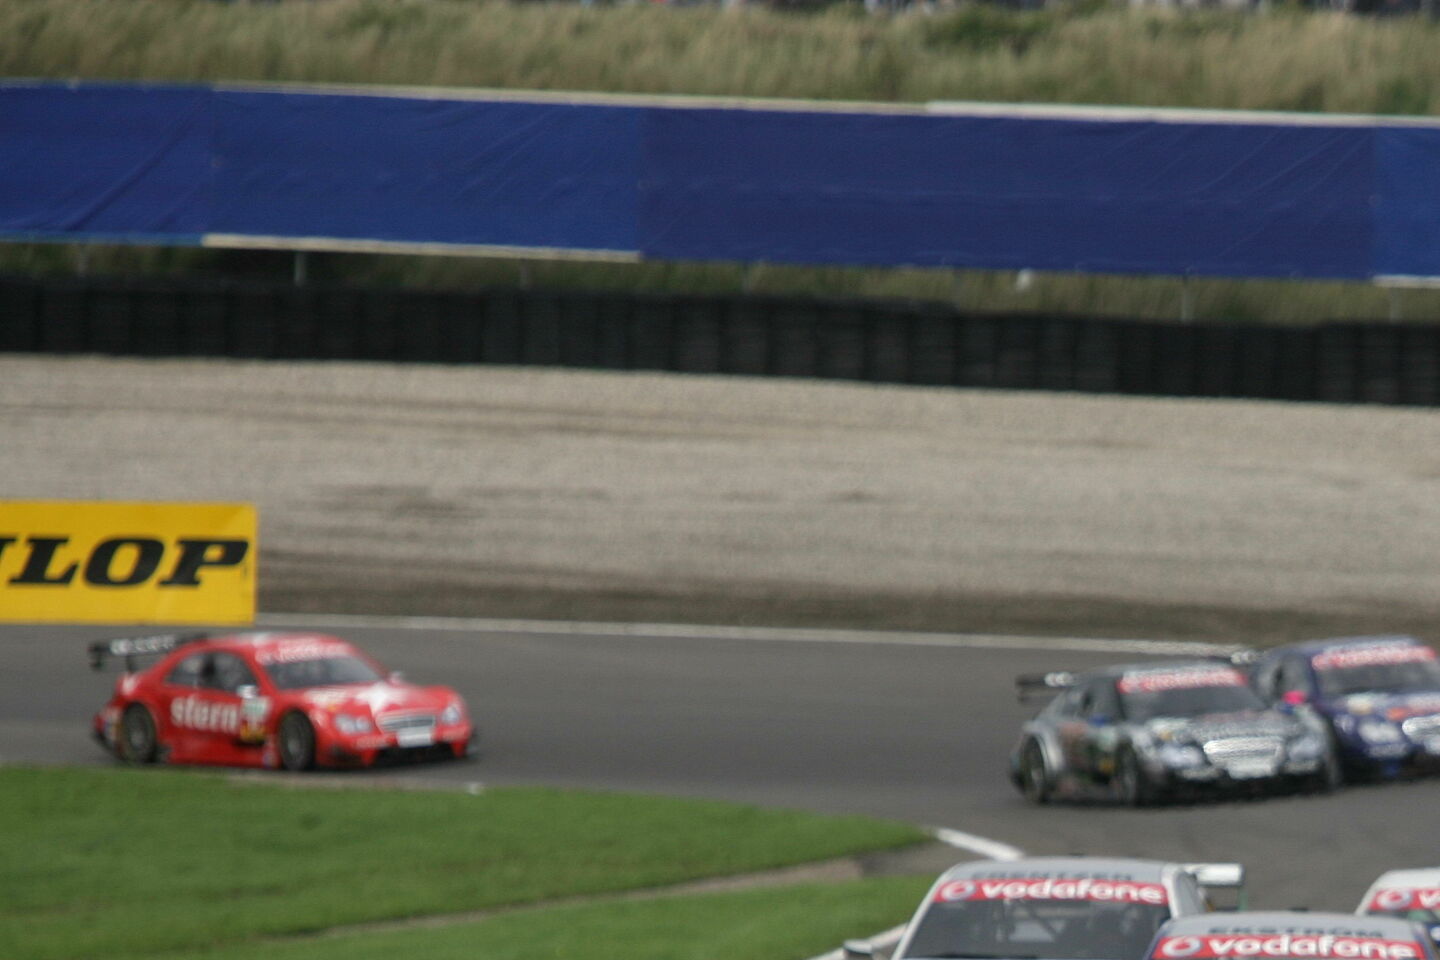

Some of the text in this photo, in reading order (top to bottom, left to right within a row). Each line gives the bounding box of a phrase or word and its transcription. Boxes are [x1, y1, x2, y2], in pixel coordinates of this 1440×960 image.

[0, 537, 248, 587] LOP
[170, 694, 238, 734] stern
[982, 879, 1162, 903] vodafone
[1208, 934, 1416, 960] vodafone
